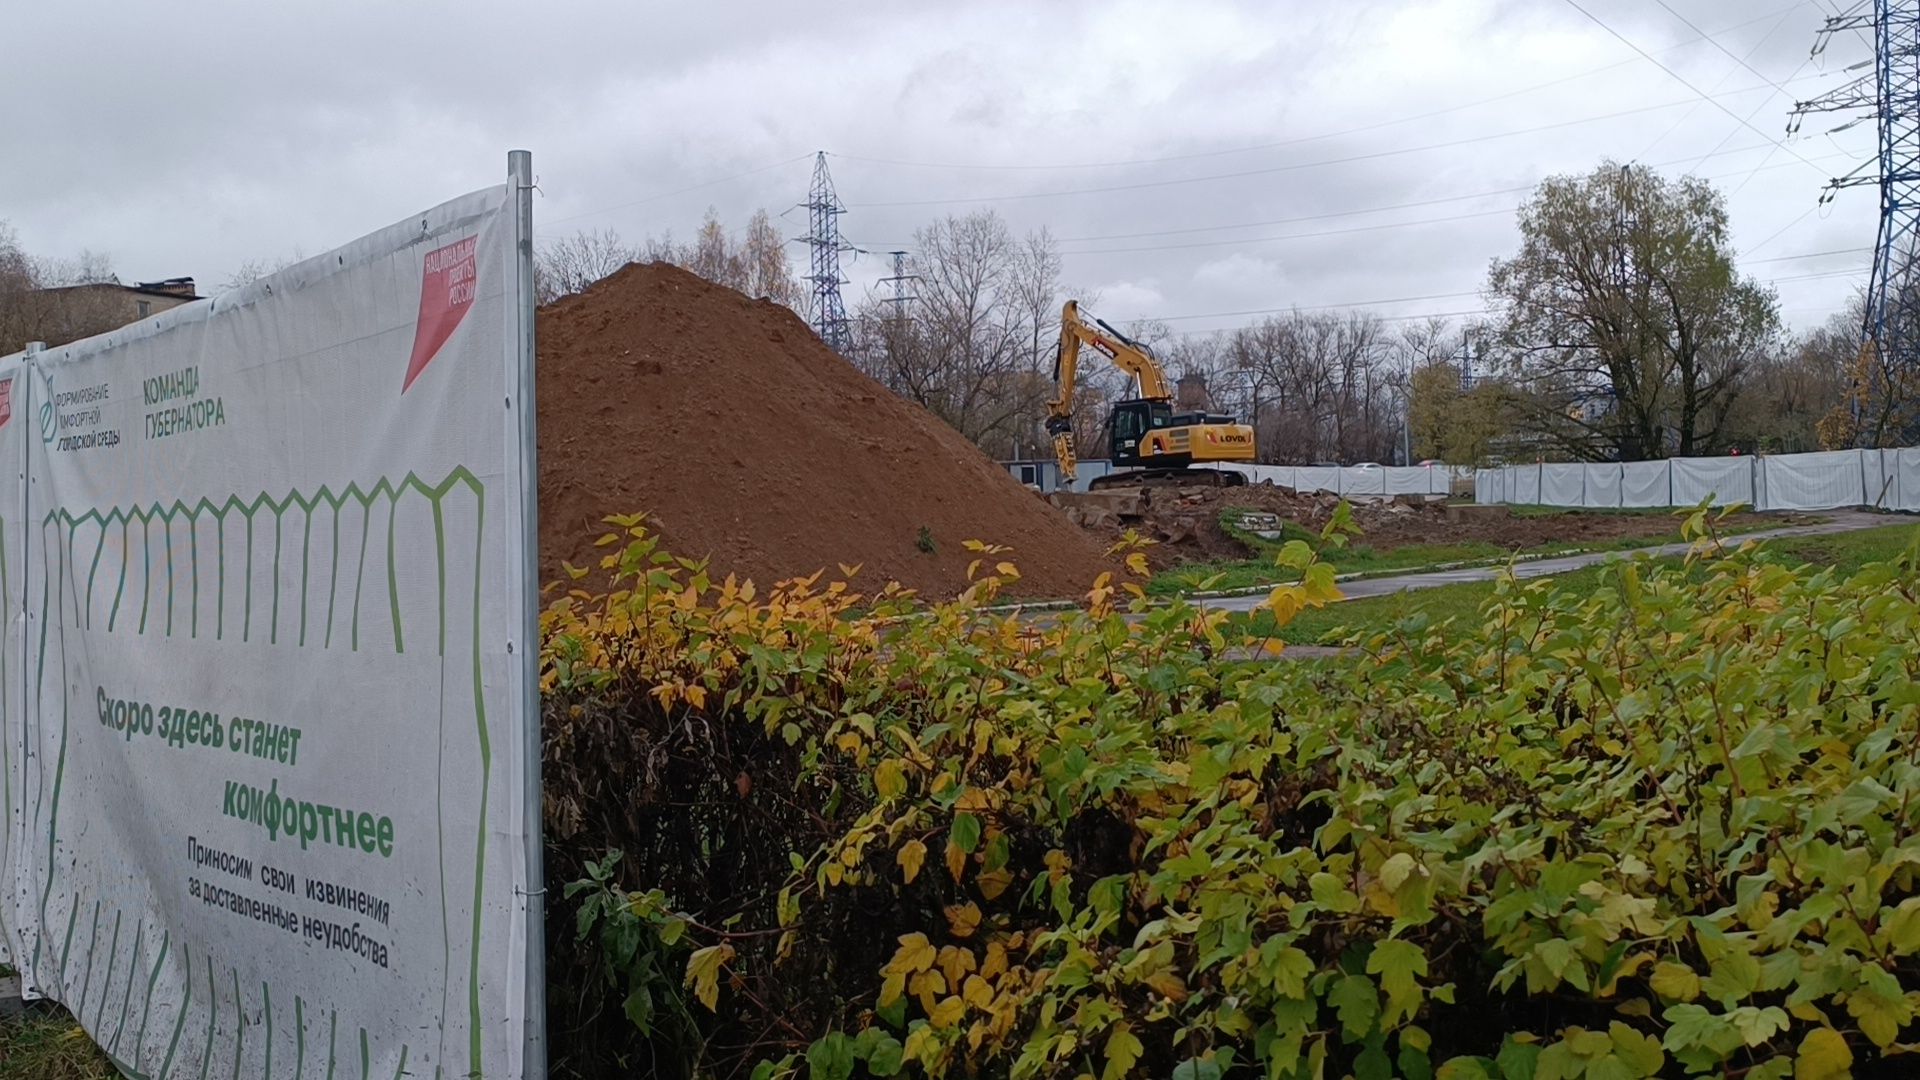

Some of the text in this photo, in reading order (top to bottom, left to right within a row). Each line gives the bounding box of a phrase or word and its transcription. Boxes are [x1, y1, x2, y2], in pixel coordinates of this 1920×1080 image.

[143, 365, 200, 405] КОМАНДА
[145, 397, 225, 440] ГУБЕРНАТОРА
[97, 430, 121, 448] СРЕДЫ
[97, 685, 301, 765] Скоро здесь станет
[222, 778, 394, 858] комфортнее
[187, 836, 390, 926] Приносим свои извинения
[188, 876, 388, 968] за доставленные неудобства
